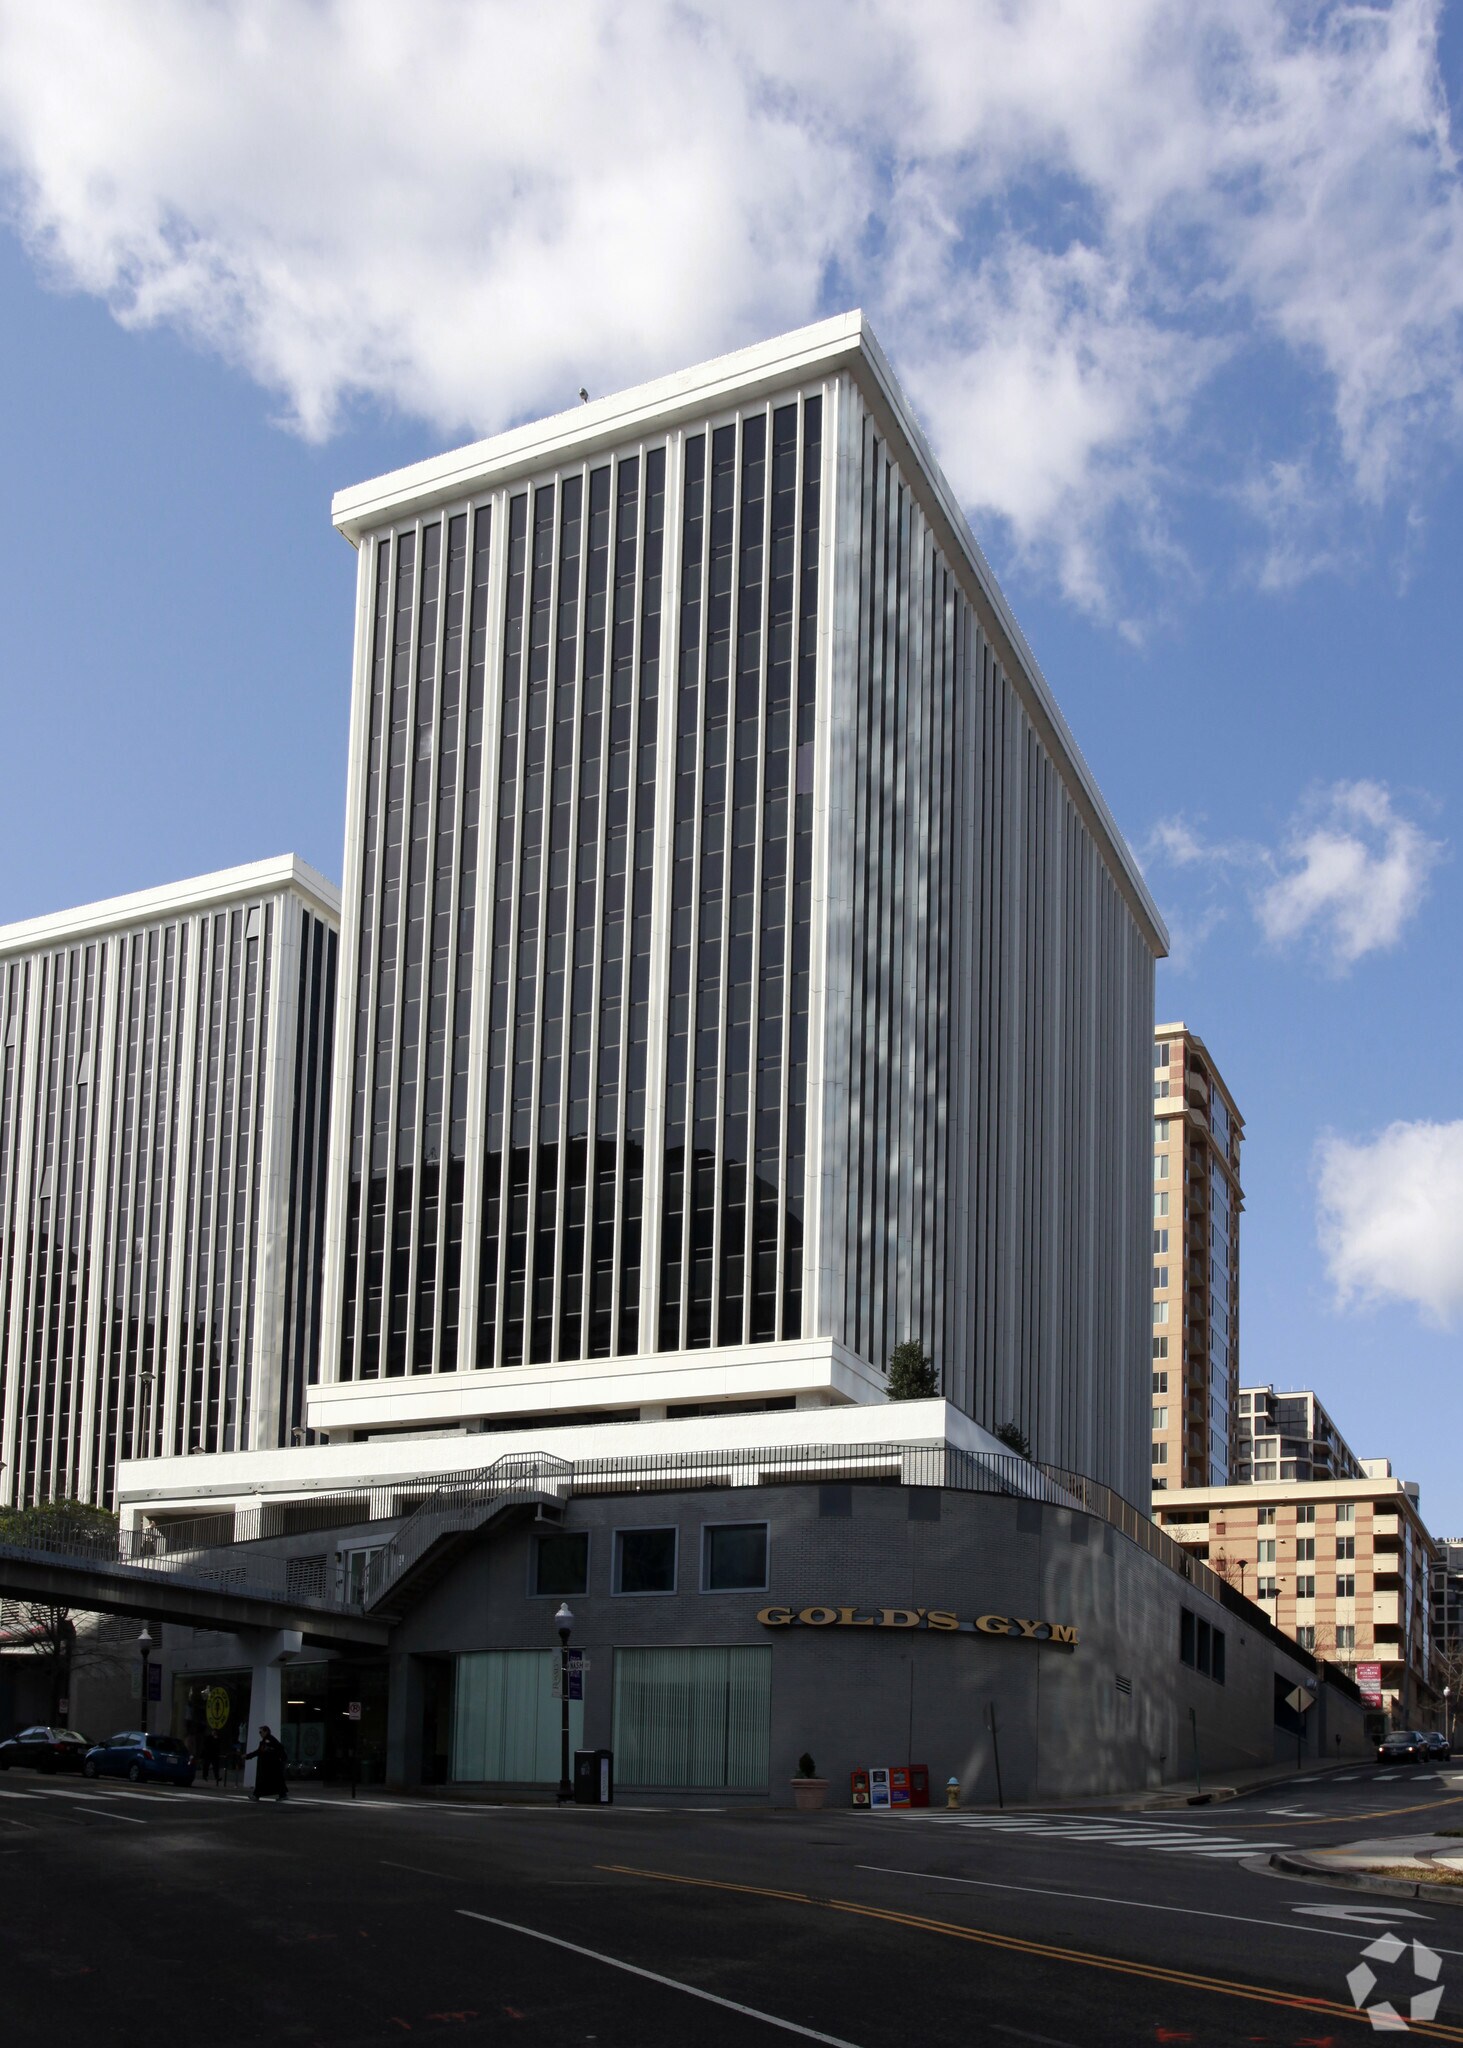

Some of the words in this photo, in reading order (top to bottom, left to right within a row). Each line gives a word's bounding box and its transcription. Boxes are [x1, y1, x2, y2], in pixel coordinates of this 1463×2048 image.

[756, 1607, 960, 1630] GOLD'S
[976, 1614, 1079, 1645] GYM
[570, 1661, 583, 1669] NASH
